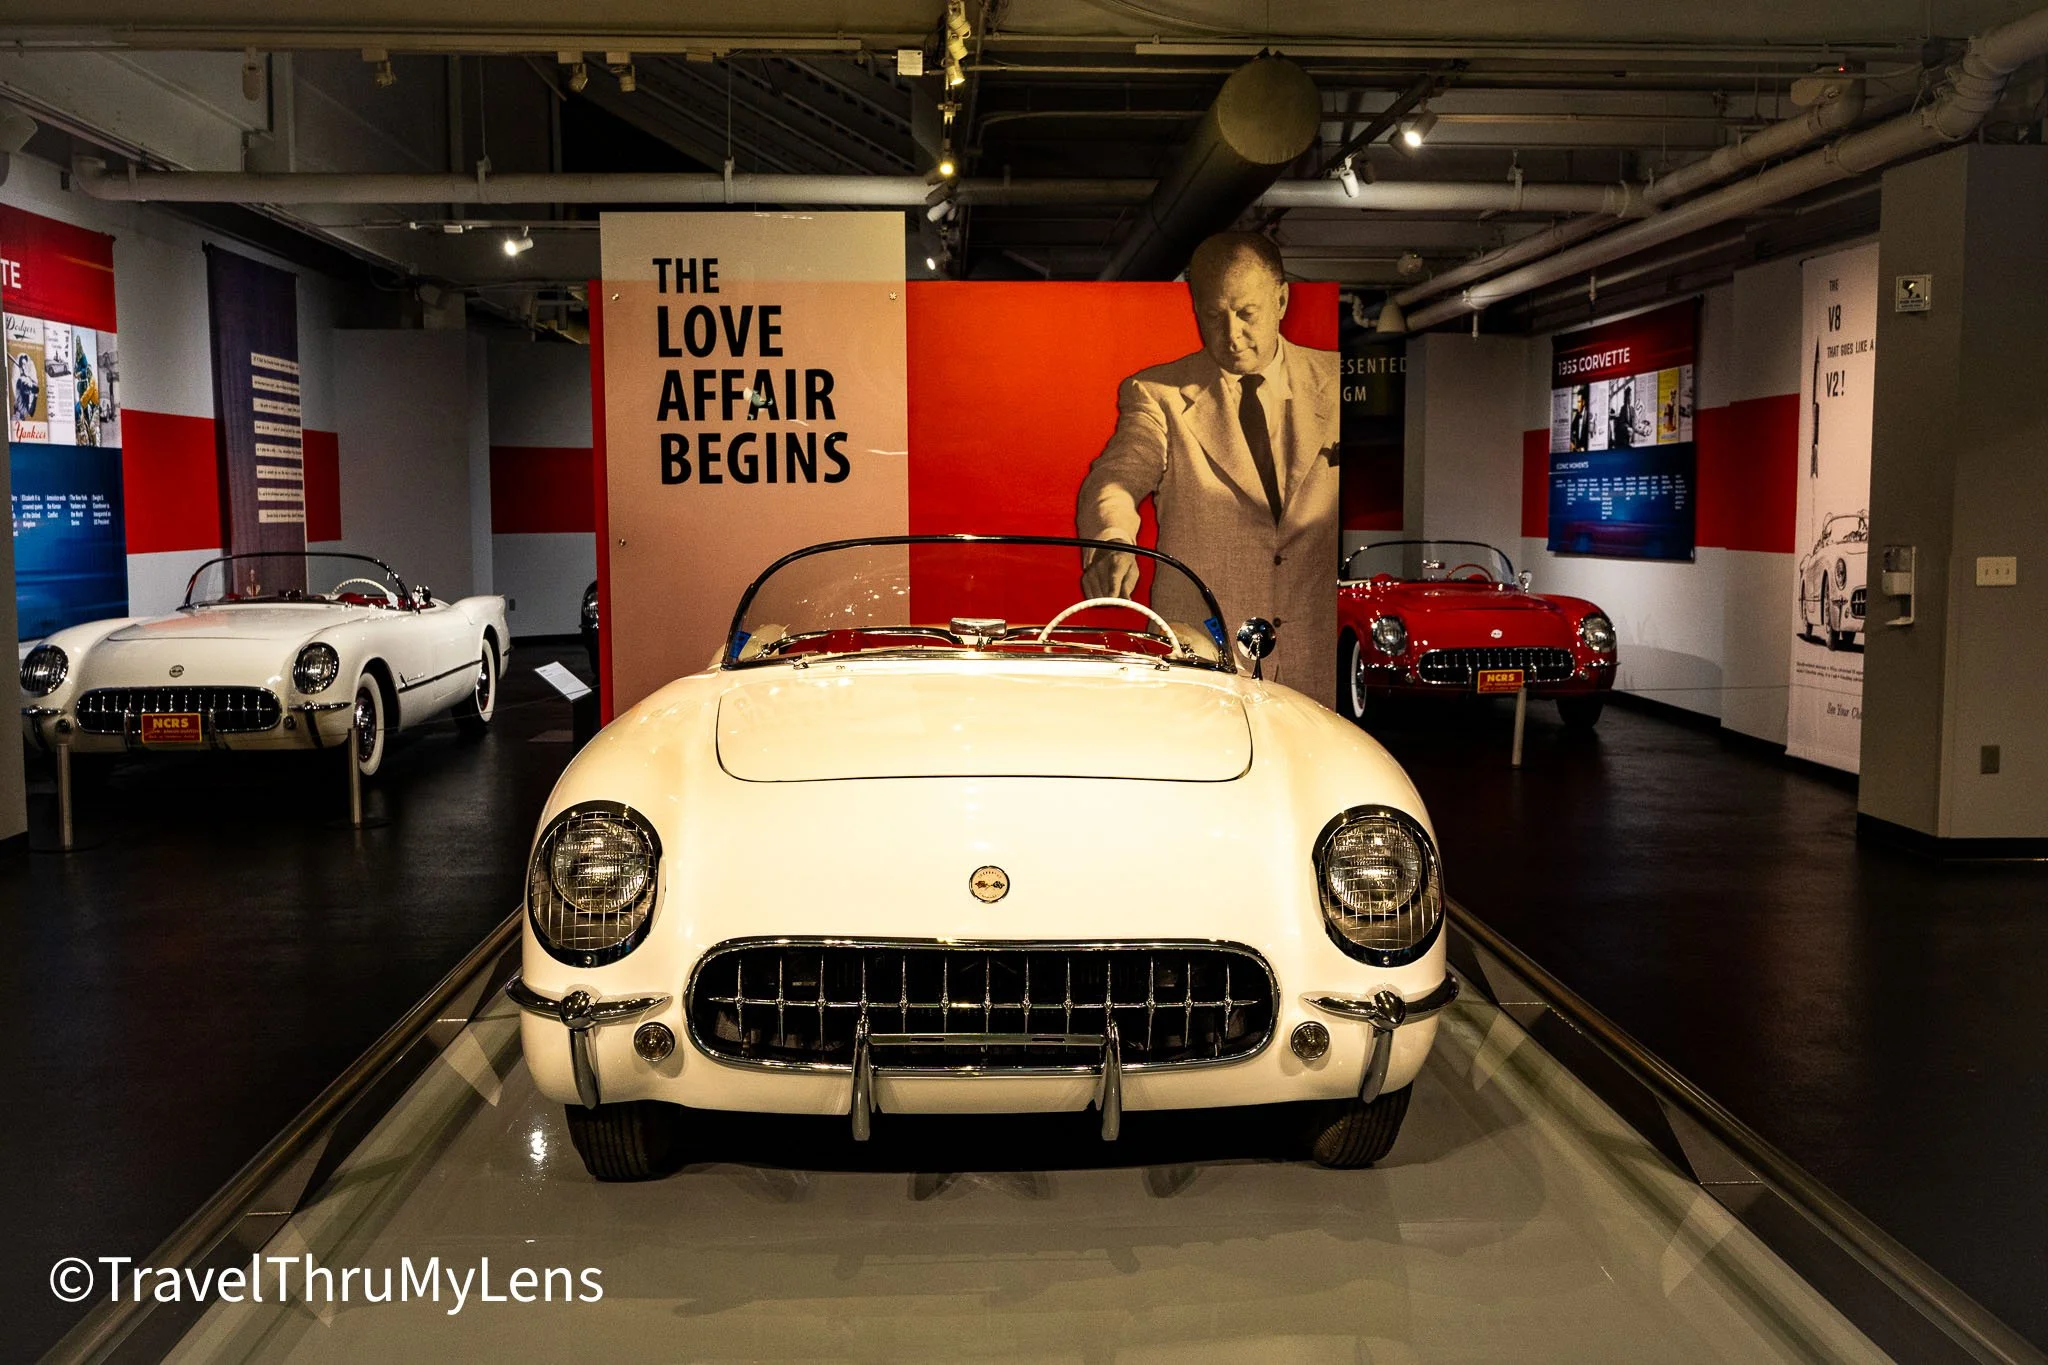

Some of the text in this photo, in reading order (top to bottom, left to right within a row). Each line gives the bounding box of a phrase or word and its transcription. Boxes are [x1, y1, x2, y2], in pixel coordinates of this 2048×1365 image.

[0, 258, 22, 289] TE
[652, 257, 720, 293] THE
[1829, 279, 1839, 291] THE
[1828, 304, 1842, 332] V8
[657, 304, 783, 358] LOVE
[1579, 347, 1631, 372] CORVETTE
[1827, 338, 1874, 358] THAT GOES LIKE A
[656, 368, 836, 421] AFFAIR
[1343, 386, 1367, 402] GM
[660, 431, 851, 485] BEGINS
[1487, 673, 1515, 682] NCRS
[152, 717, 189, 728] NCRS
[1851, 706, 1862, 720] Ch
